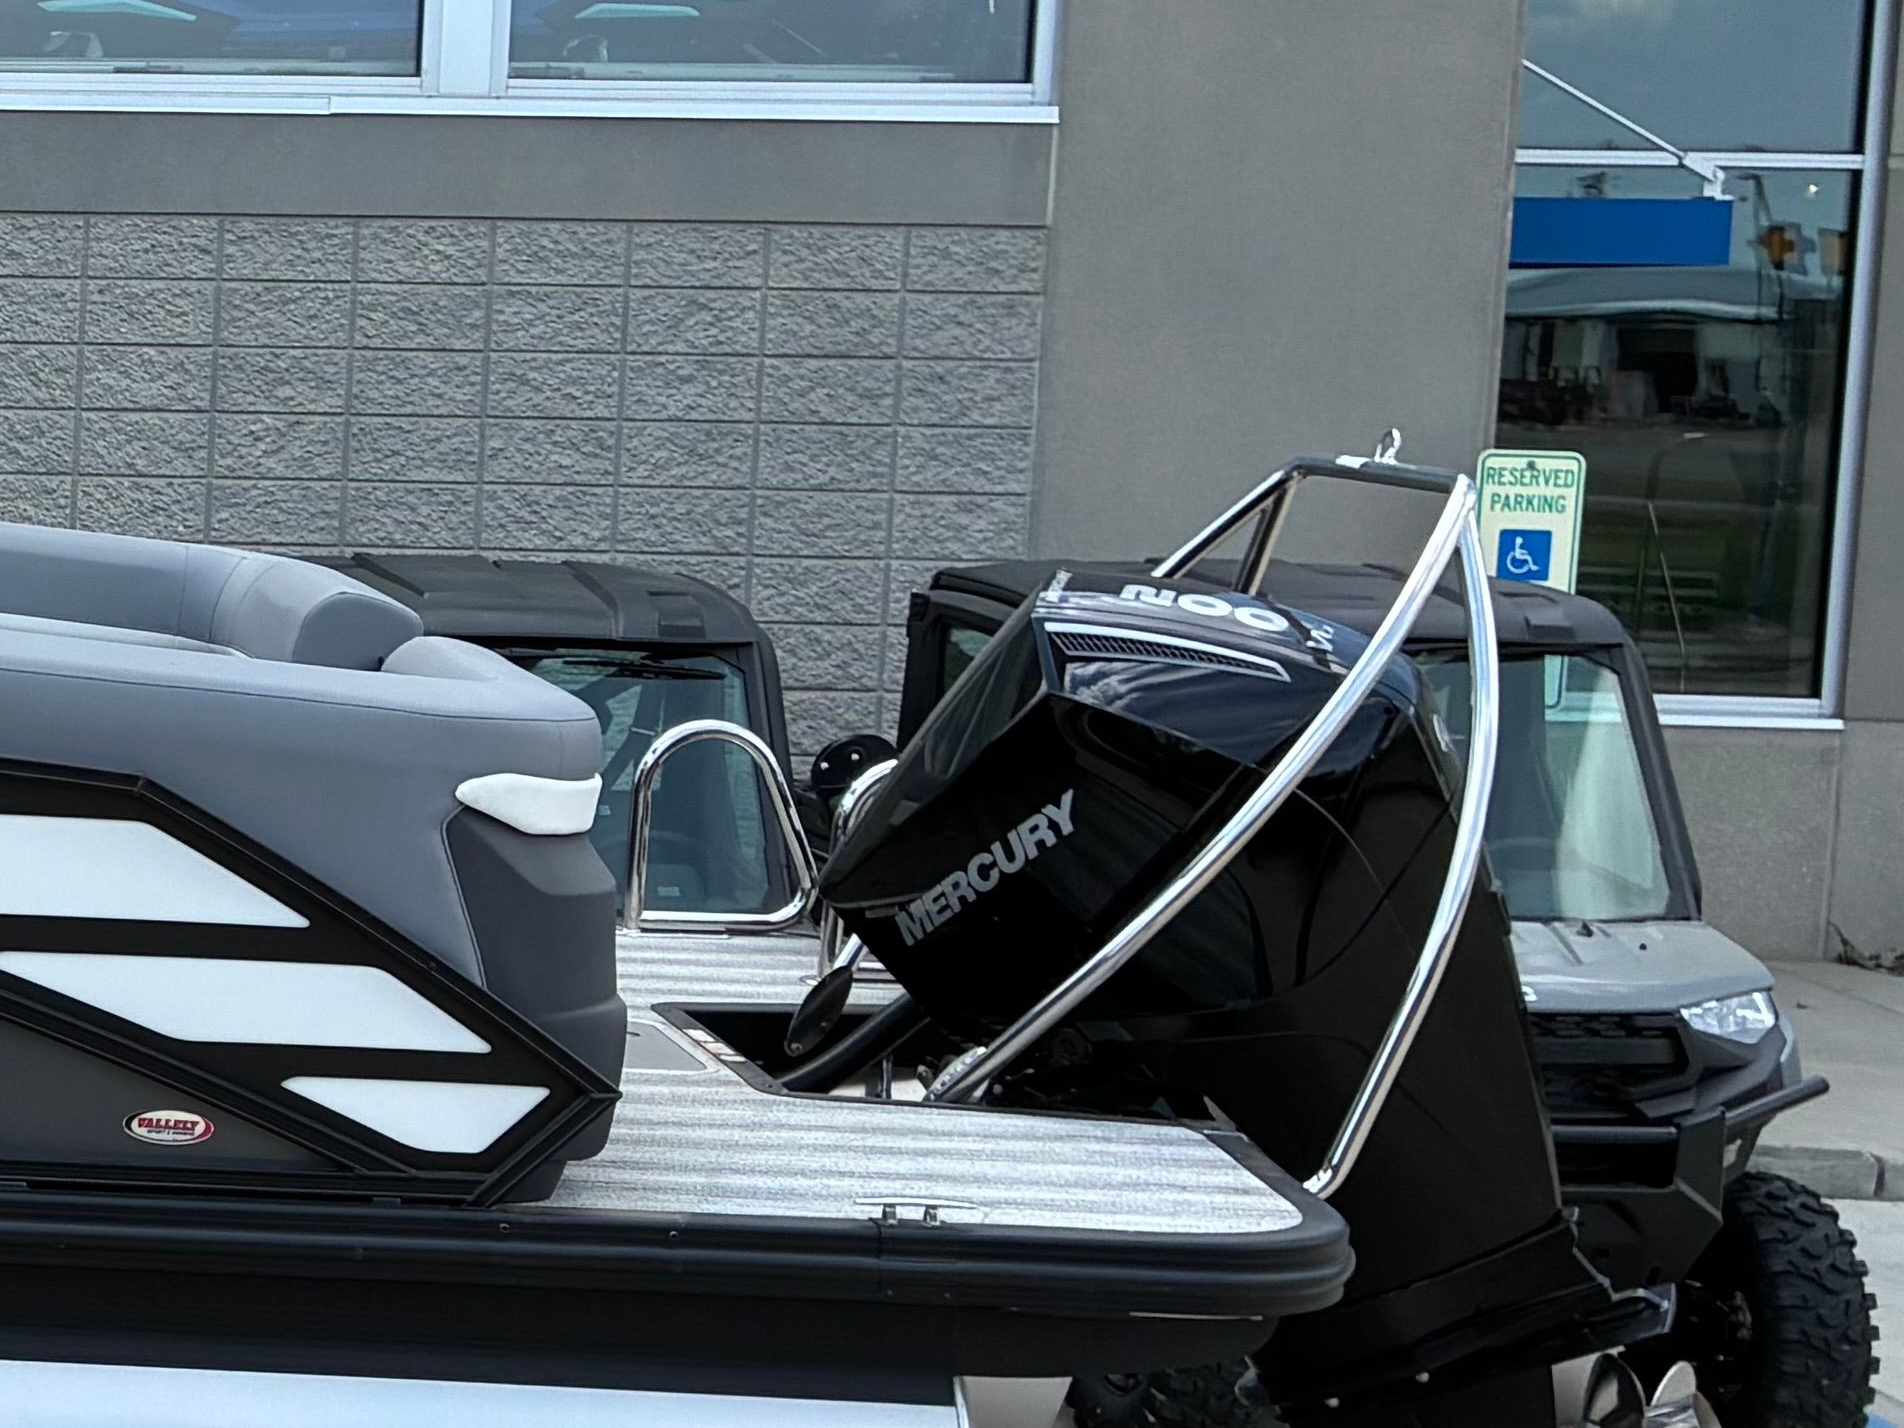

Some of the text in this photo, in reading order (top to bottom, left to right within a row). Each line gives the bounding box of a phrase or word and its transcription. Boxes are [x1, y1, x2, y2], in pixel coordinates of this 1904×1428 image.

[1486, 466, 1576, 488] RESERVED
[1490, 492, 1567, 514] PARKING
[1120, 584, 1289, 632] 200
[894, 788, 1075, 947] MERCURY
